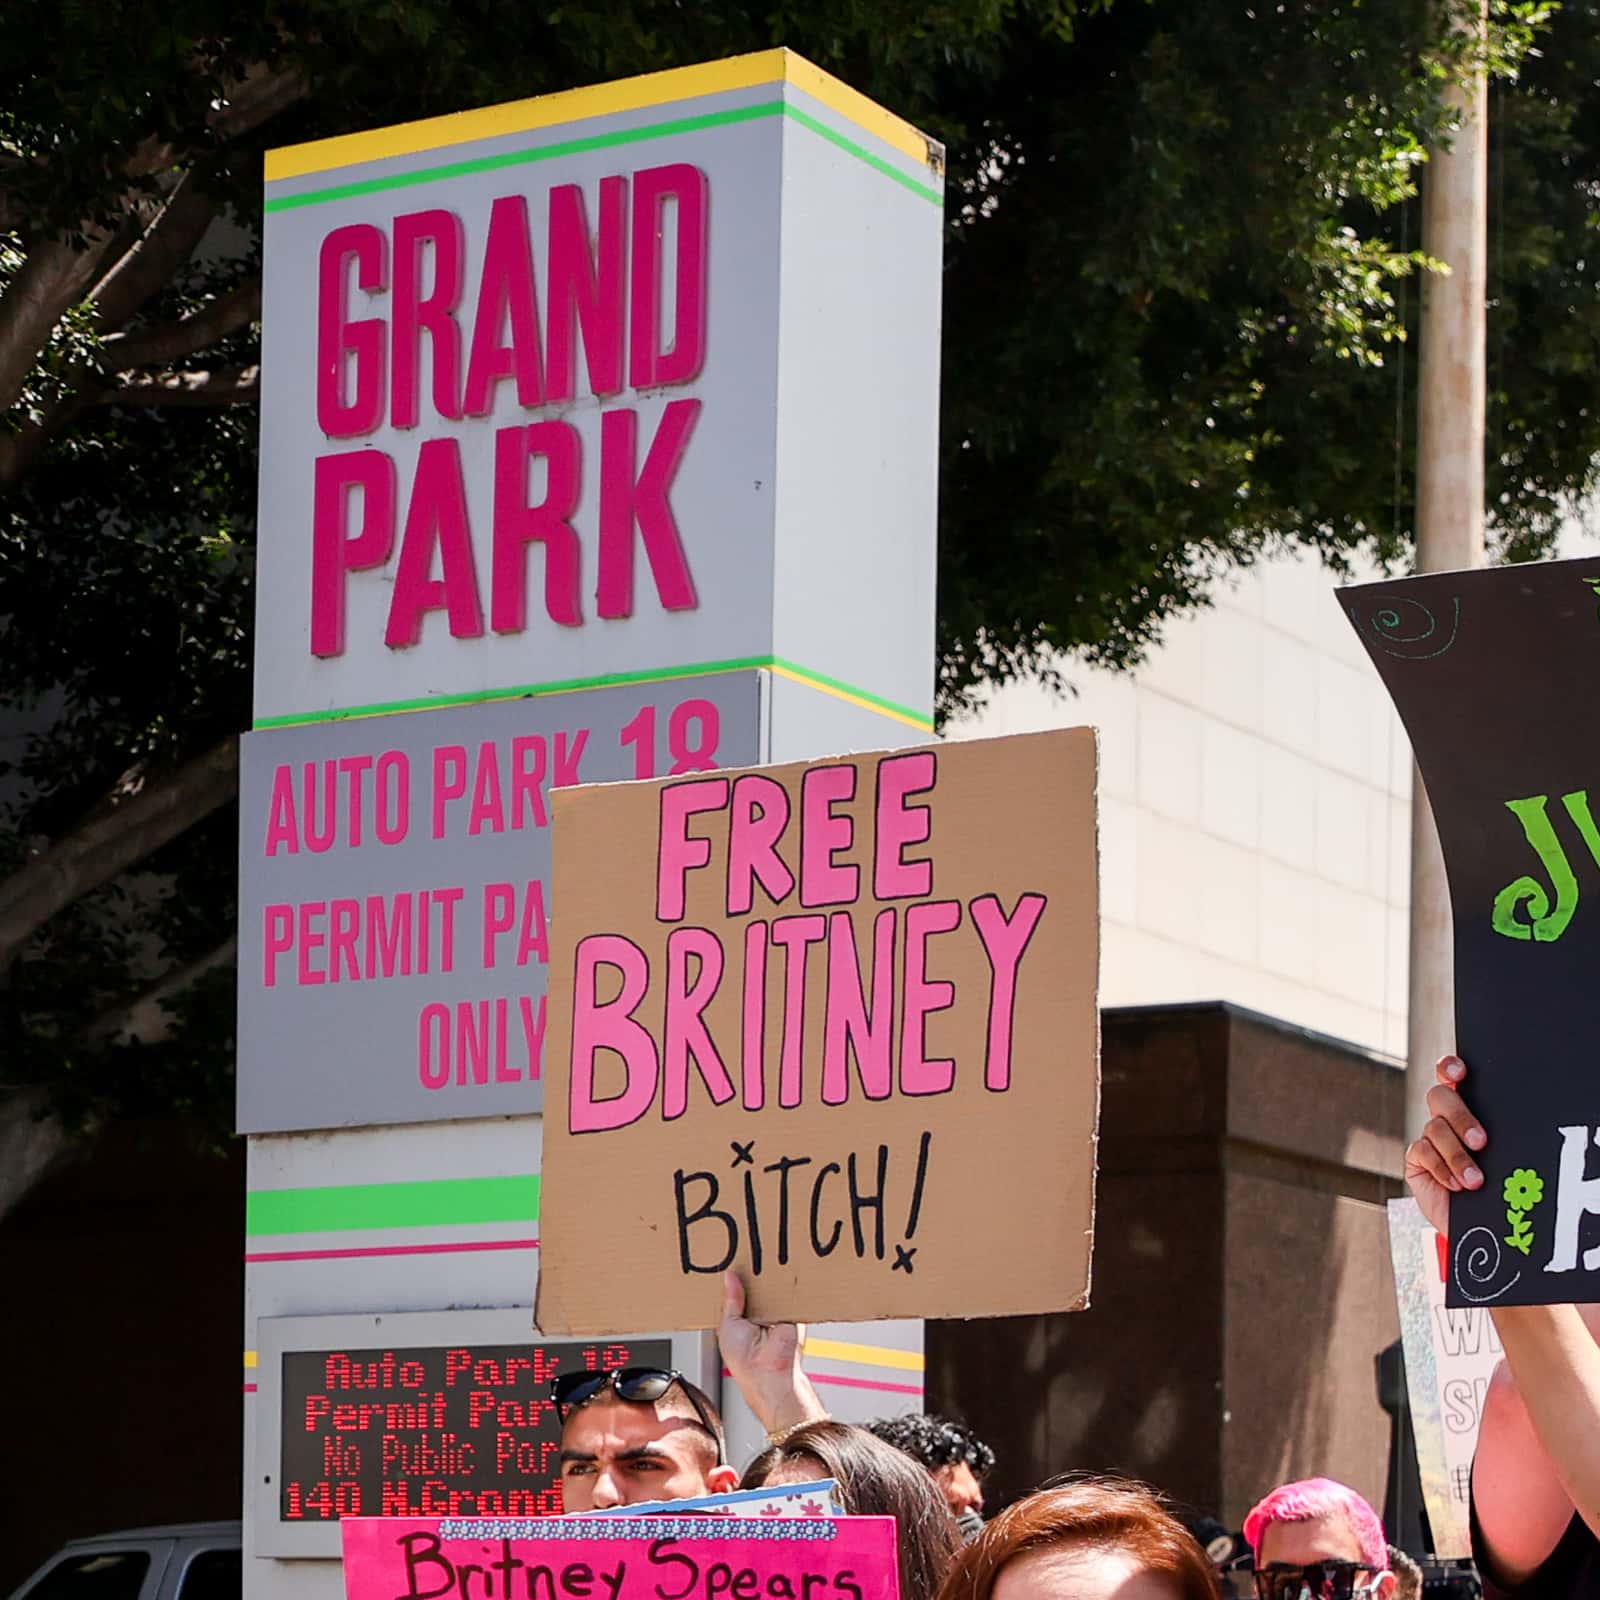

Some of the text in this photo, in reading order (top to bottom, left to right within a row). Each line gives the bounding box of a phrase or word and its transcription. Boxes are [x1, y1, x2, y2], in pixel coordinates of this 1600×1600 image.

[317, 163, 709, 438] GRAND
[310, 397, 702, 659] PARK
[264, 749, 411, 858] AUTO
[655, 751, 937, 923] FREE
[263, 887, 465, 989] PERMIT
[418, 995, 549, 1091] ONLY
[568, 892, 1048, 1135] BRITNEY
[304, 1391, 448, 1432] Permit
[325, 1352, 425, 1391] Auto
[445, 1348, 560, 1388] Park
[285, 1481, 362, 1518] 140
[323, 1435, 361, 1477] No
[382, 1433, 476, 1477] Public
